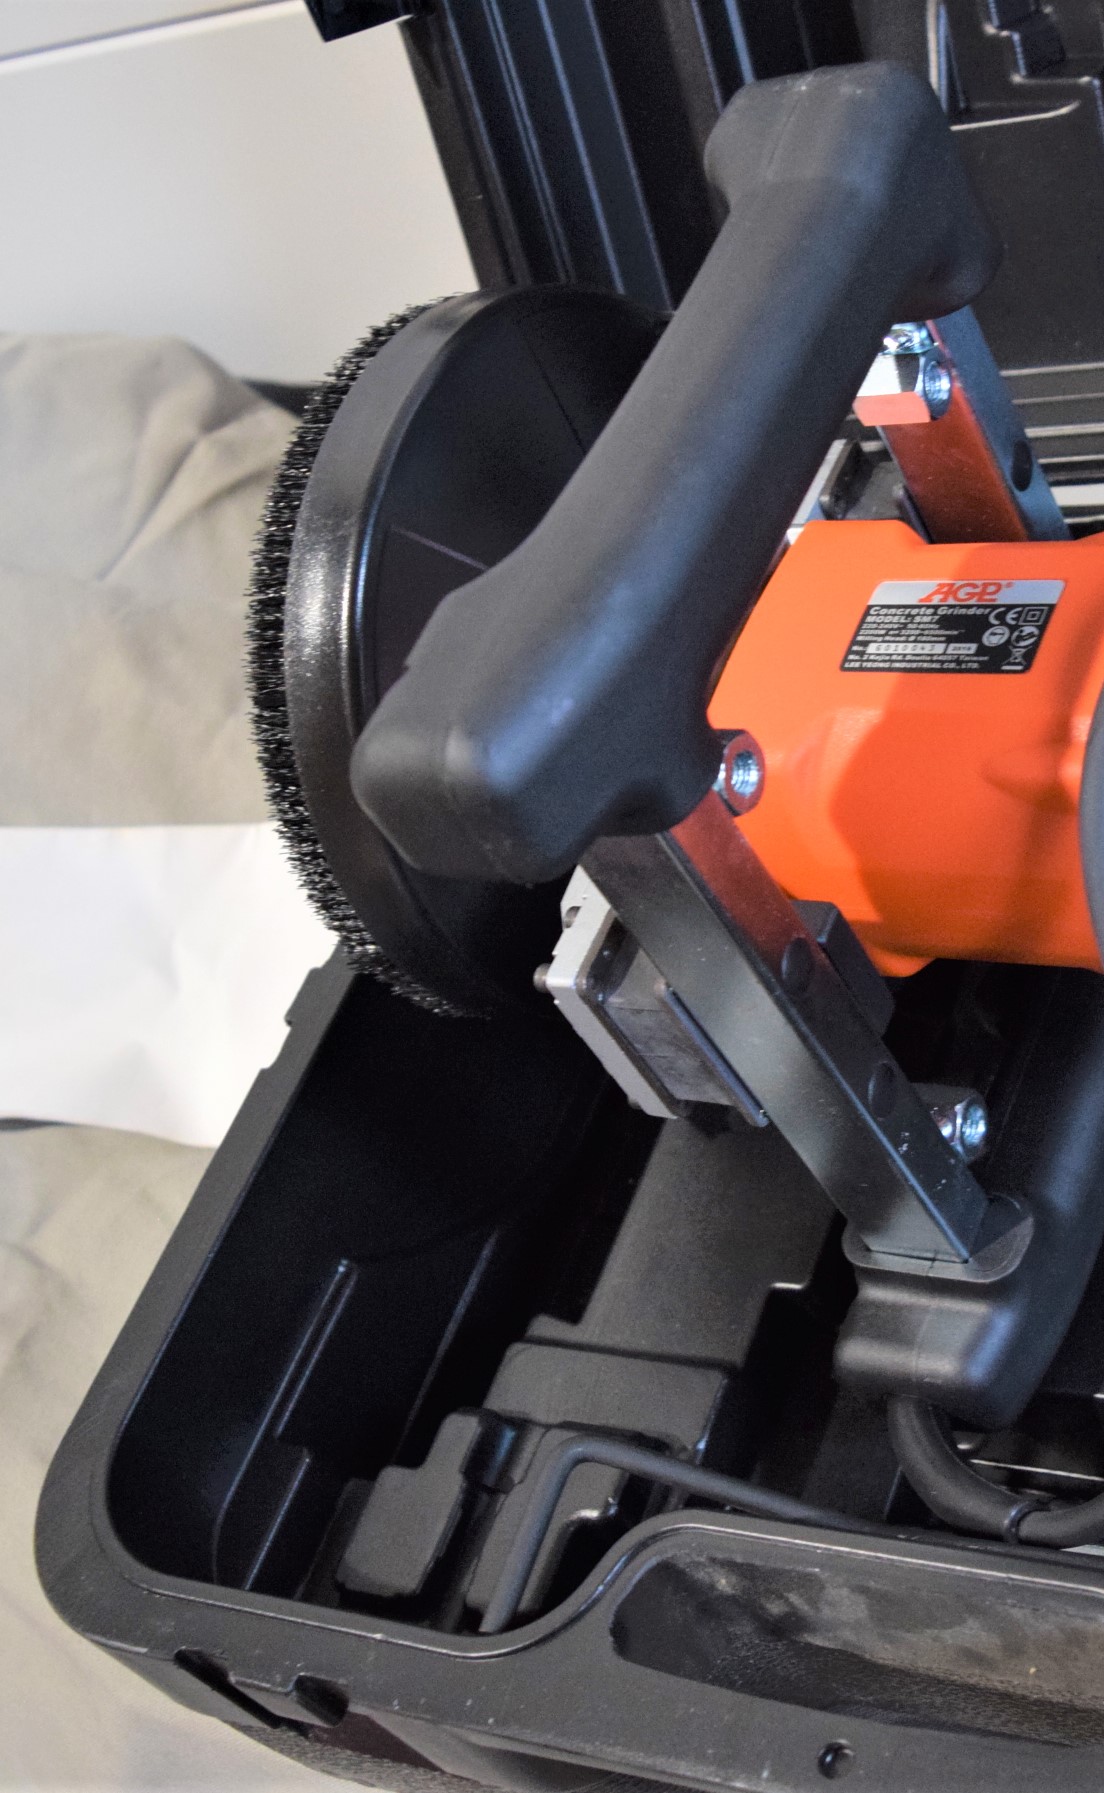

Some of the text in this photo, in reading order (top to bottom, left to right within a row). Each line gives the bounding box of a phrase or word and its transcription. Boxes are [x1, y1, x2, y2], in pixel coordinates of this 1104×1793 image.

[918, 582, 1005, 603] AGP
[869, 606, 992, 615] Concrete Grinder
[864, 615, 940, 623] MODEL: SM7
